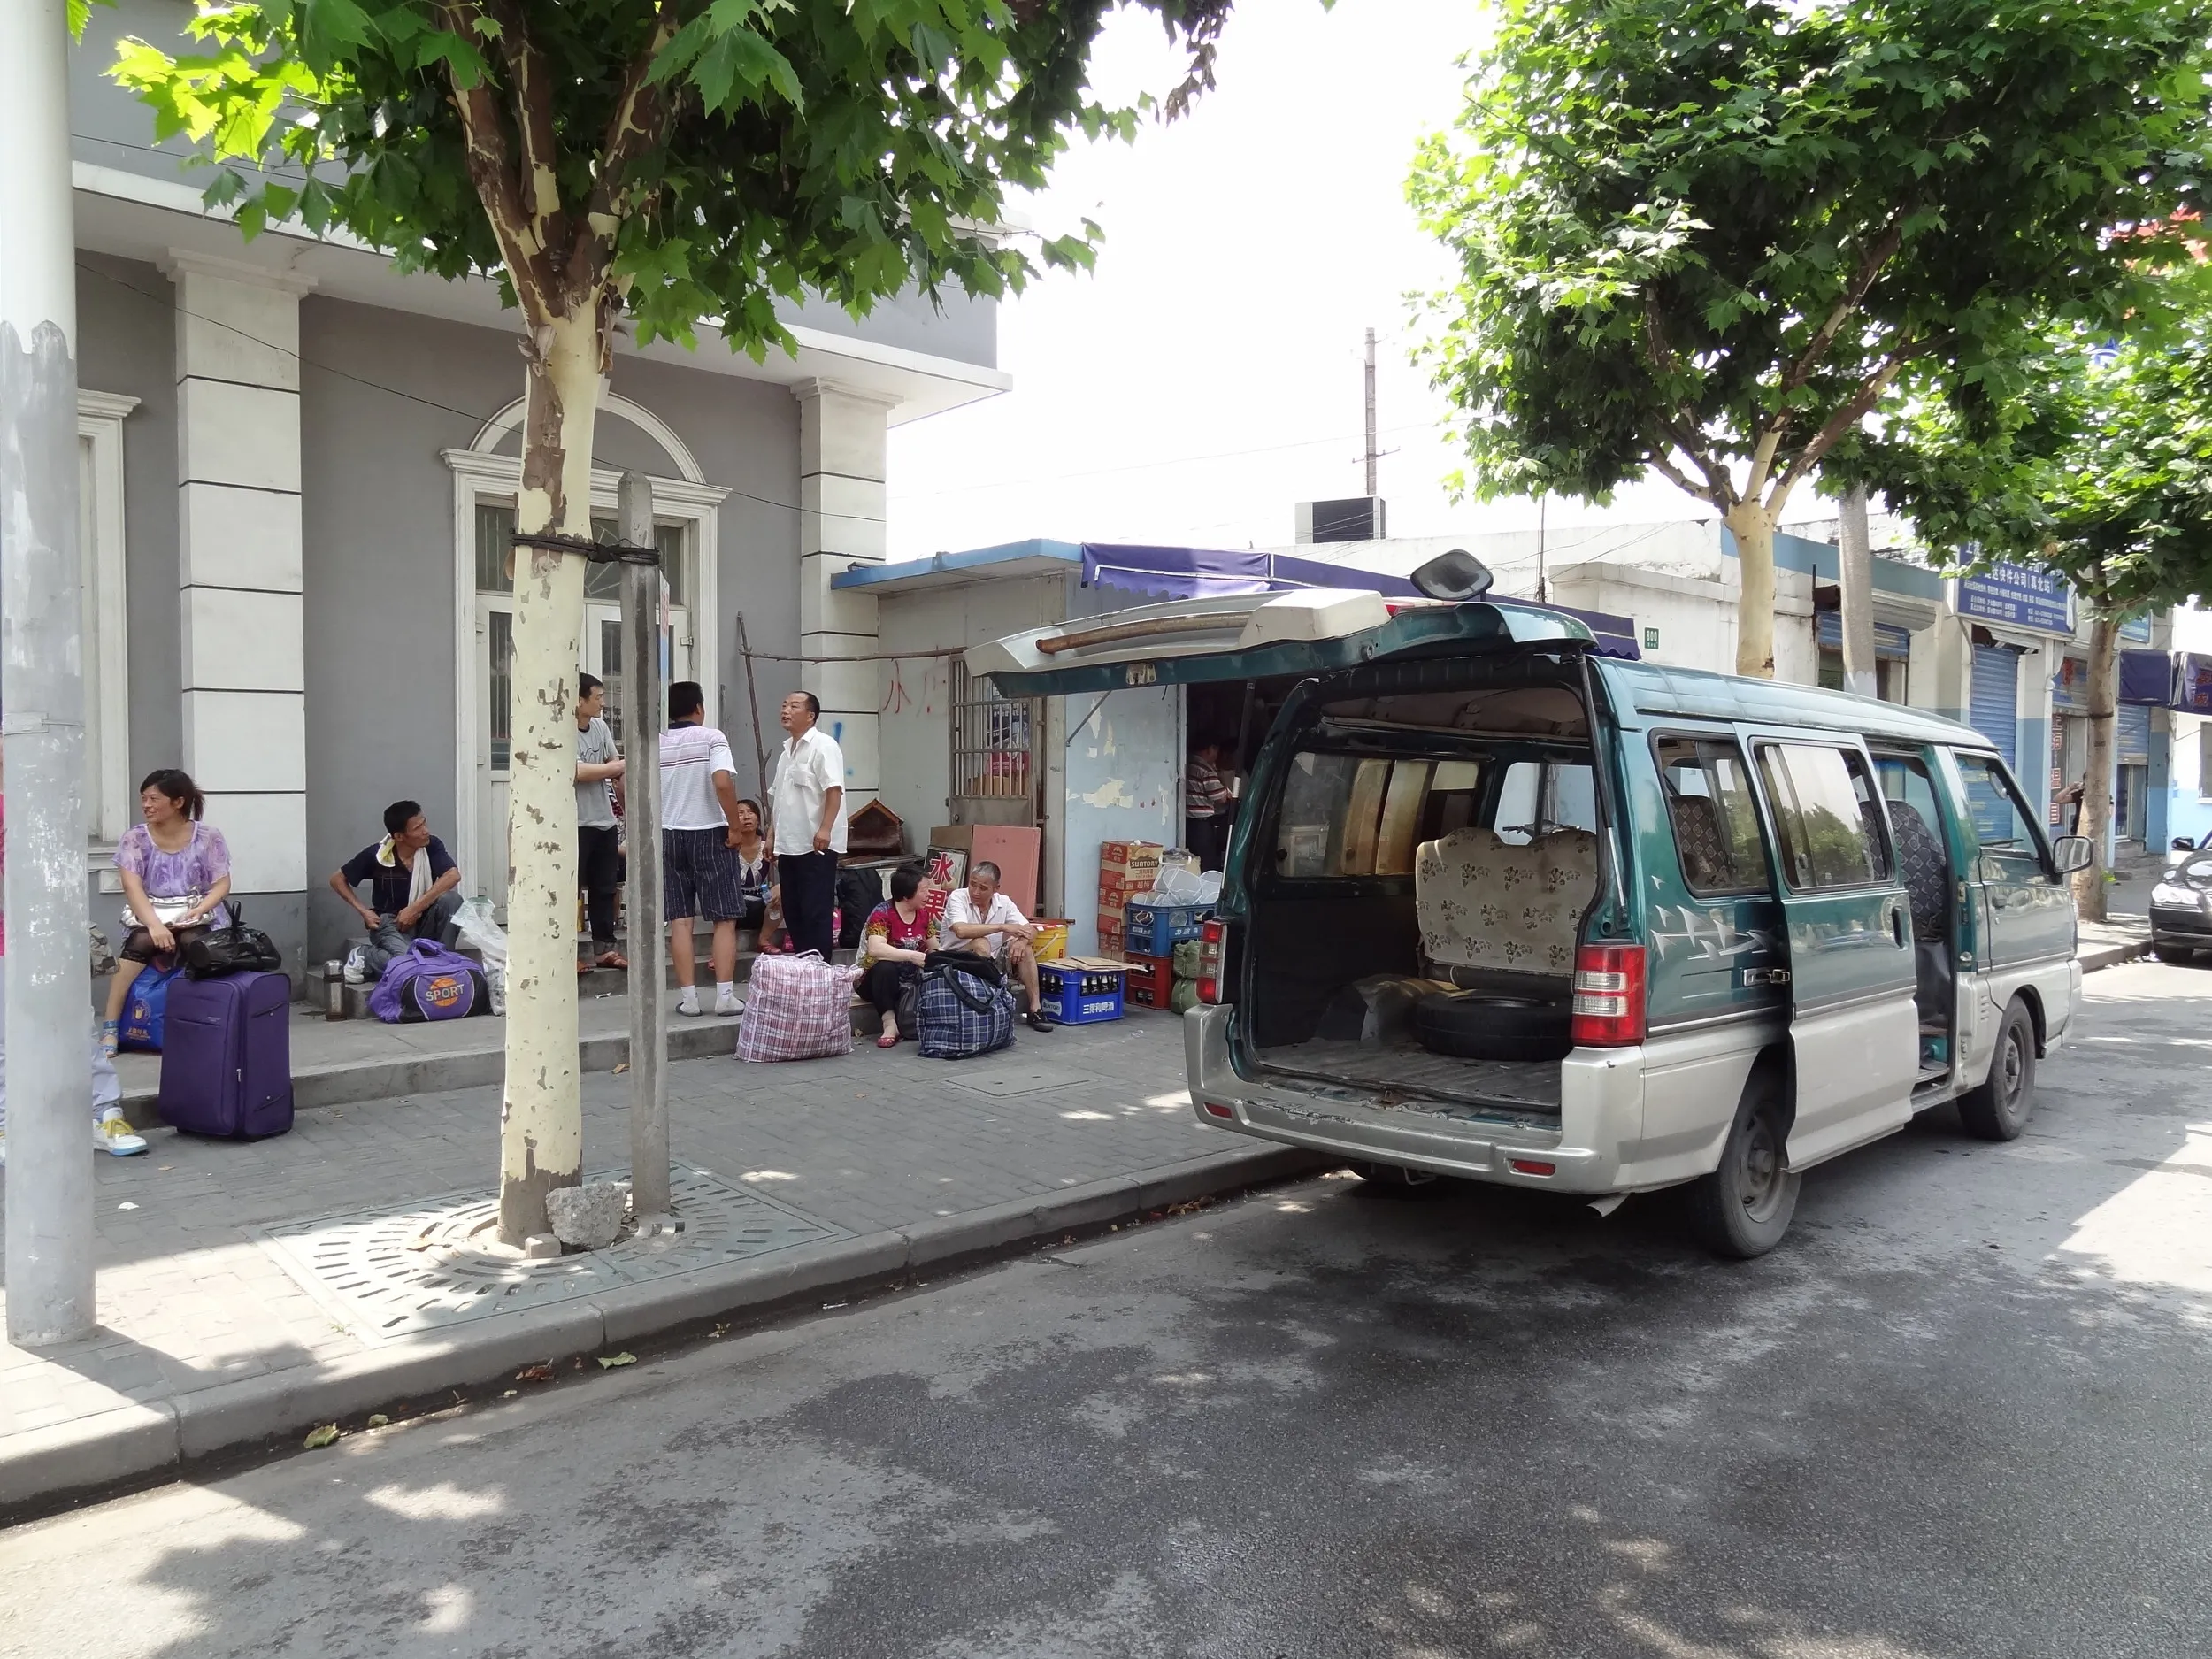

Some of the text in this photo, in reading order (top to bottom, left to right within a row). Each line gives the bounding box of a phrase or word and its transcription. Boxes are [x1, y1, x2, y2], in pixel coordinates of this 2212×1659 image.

[925, 852, 954, 921] 水果
[426, 984, 465, 1002] SPORT
[1082, 1001, 1115, 1014] 三得利啤酒
